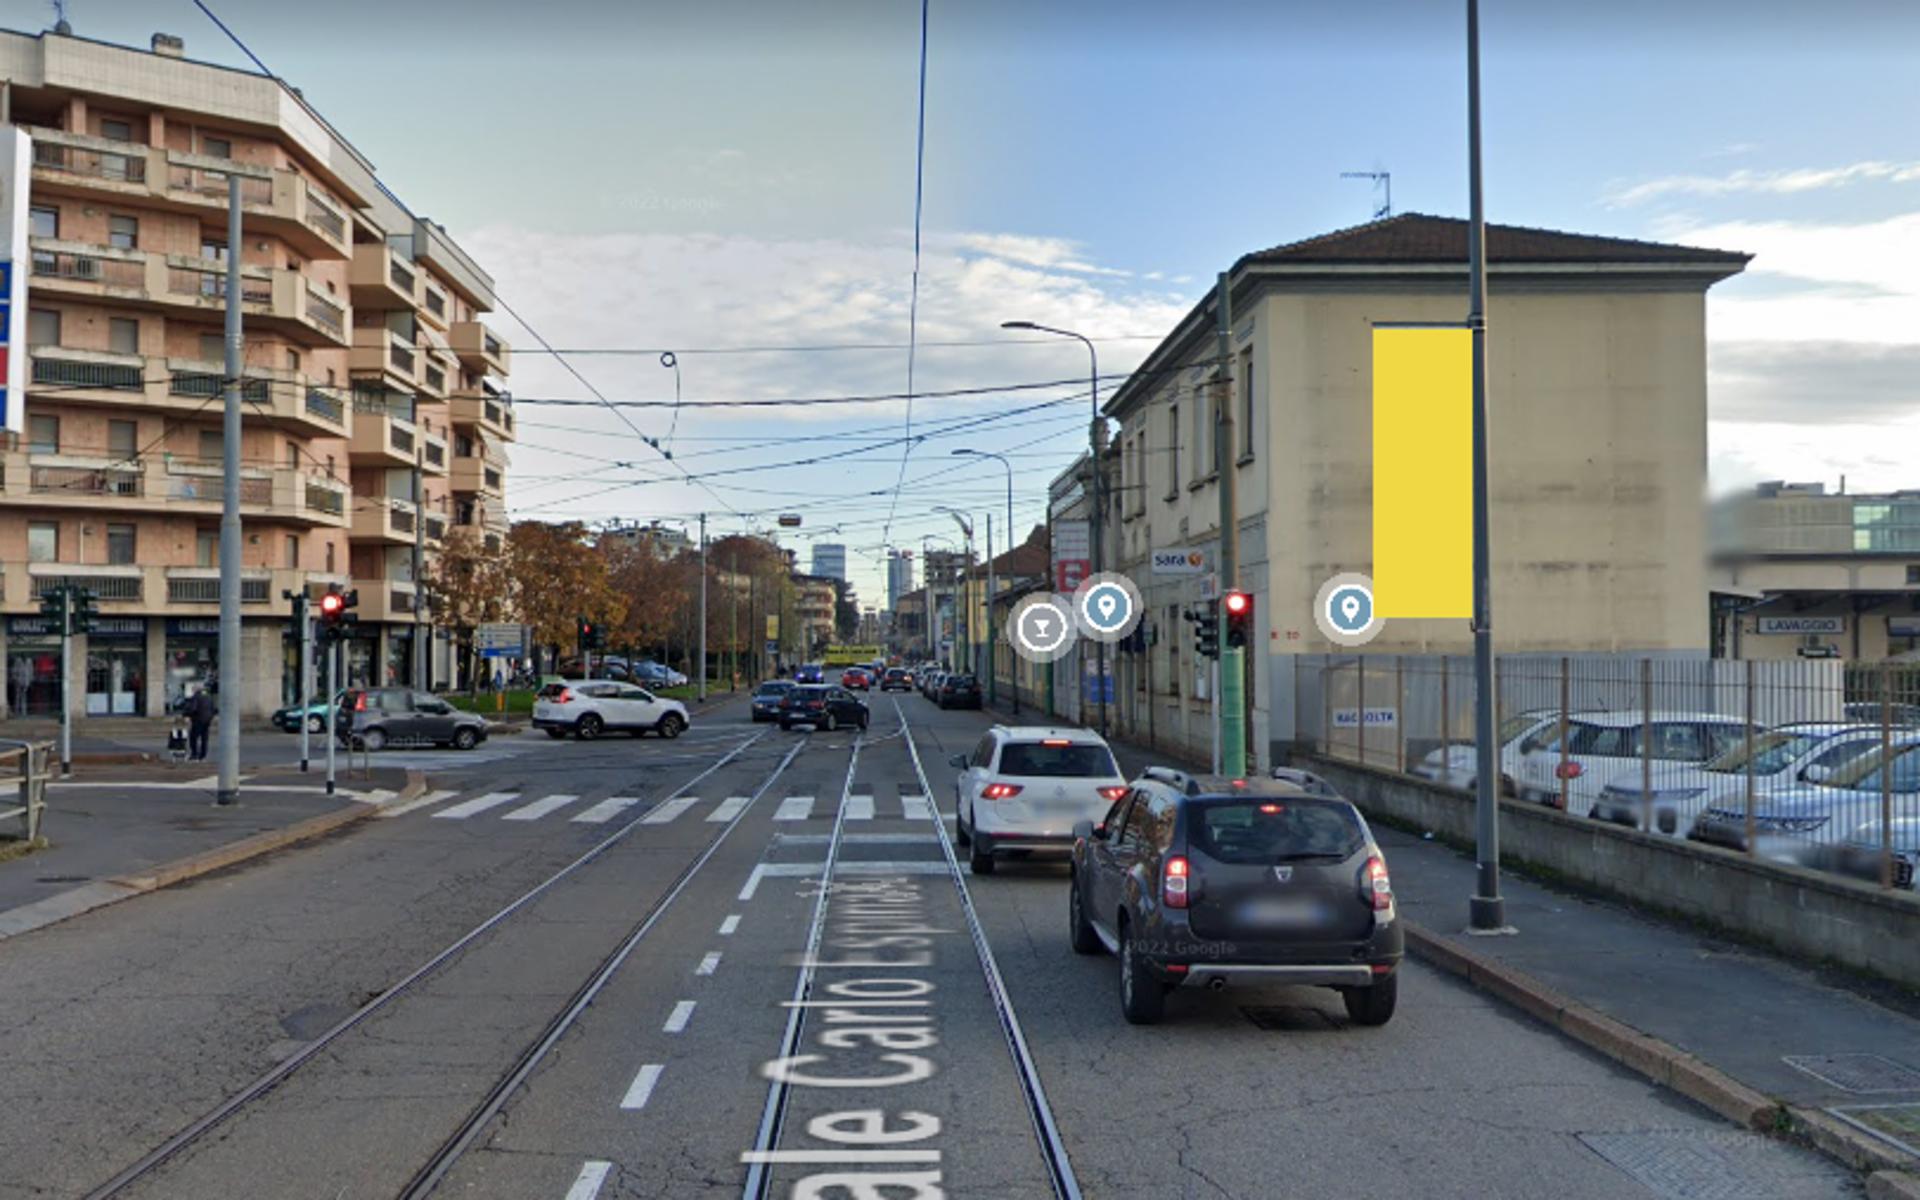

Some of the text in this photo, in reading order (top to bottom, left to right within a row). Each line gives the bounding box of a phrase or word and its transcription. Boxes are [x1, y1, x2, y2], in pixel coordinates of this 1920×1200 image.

[1154, 555, 1186, 567] sara
[1766, 619, 1837, 631] LAVAGGIO
[1336, 712, 1394, 723] RACOLTA
